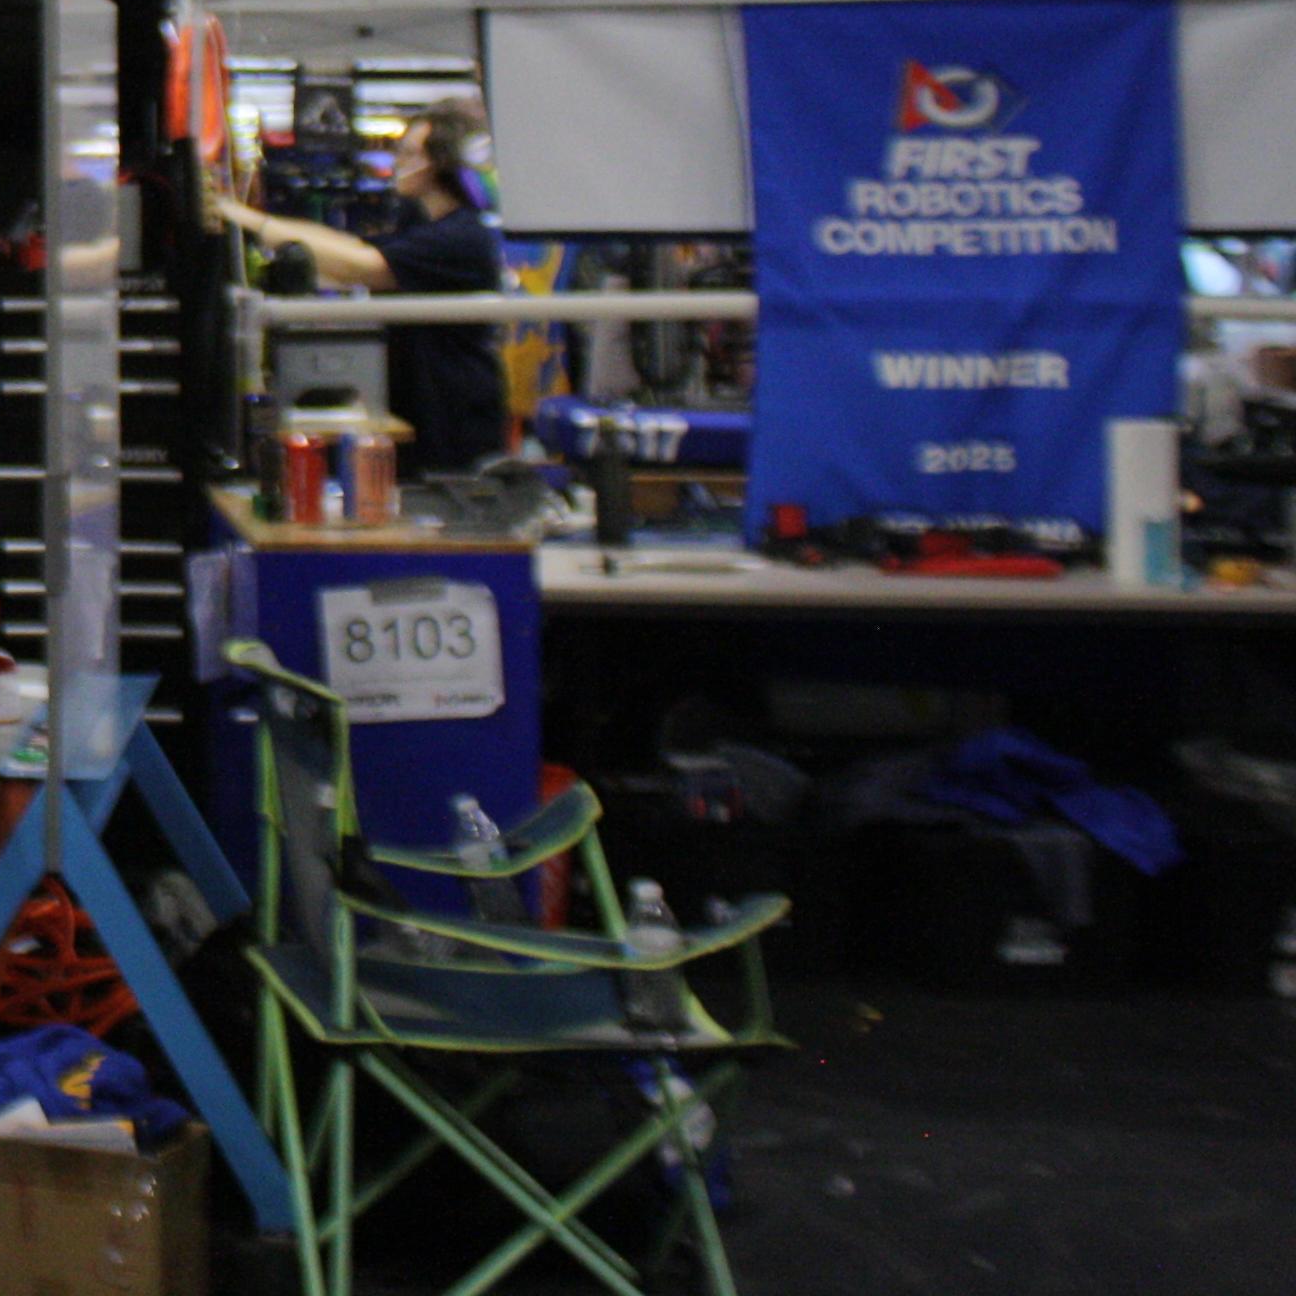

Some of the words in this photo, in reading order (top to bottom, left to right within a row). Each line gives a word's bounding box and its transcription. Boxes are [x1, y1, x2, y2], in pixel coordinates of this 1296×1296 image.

[888, 136, 1042, 180] FIRST
[848, 177, 1084, 217] ROBOTICS
[816, 216, 1119, 257] COMPETITION
[876, 350, 1069, 390] WINNER
[919, 442, 1017, 474] 2025
[345, 614, 477, 664] 8103
